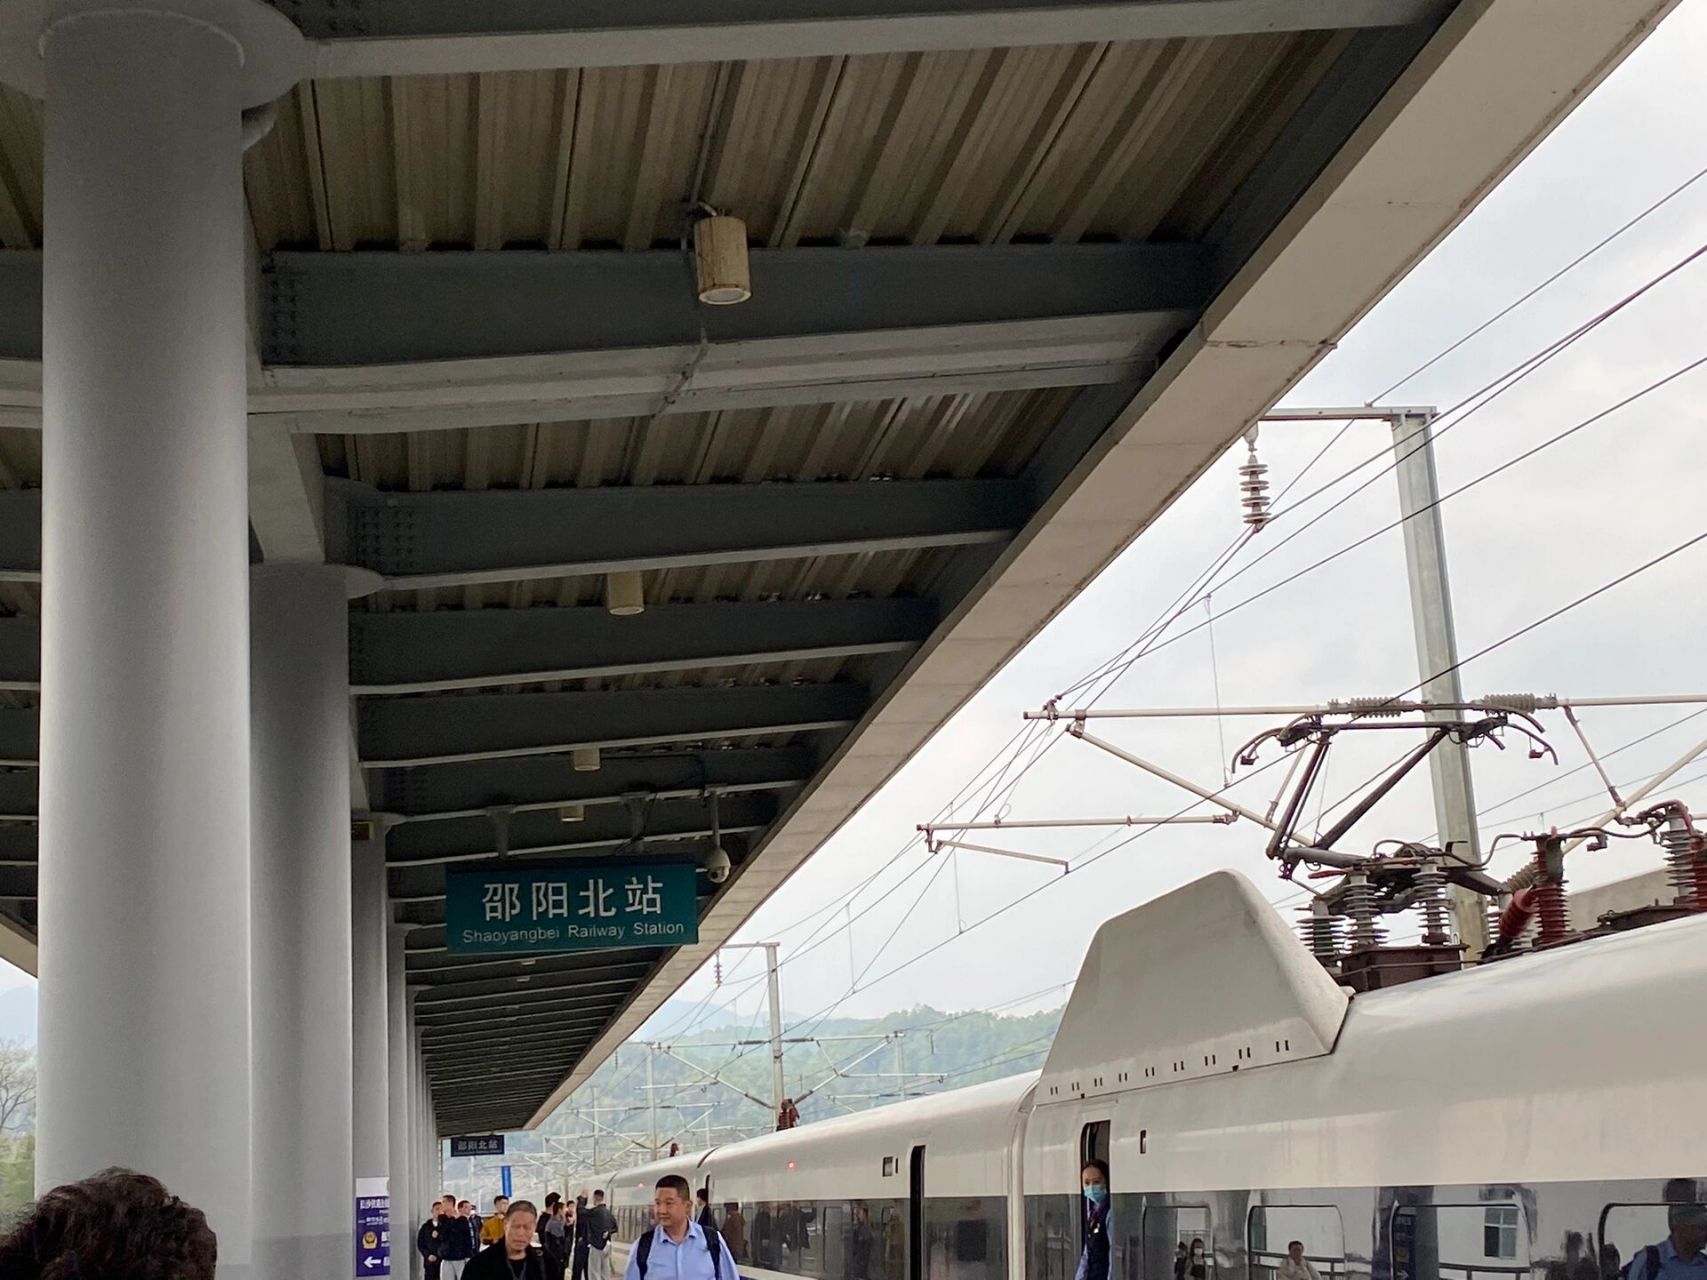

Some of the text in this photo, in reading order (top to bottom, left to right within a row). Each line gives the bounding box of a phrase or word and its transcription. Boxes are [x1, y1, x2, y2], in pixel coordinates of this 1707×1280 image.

[482, 875, 663, 922] 邵阳北站
[463, 921, 684, 945] Shaoyangbei Railway Station
